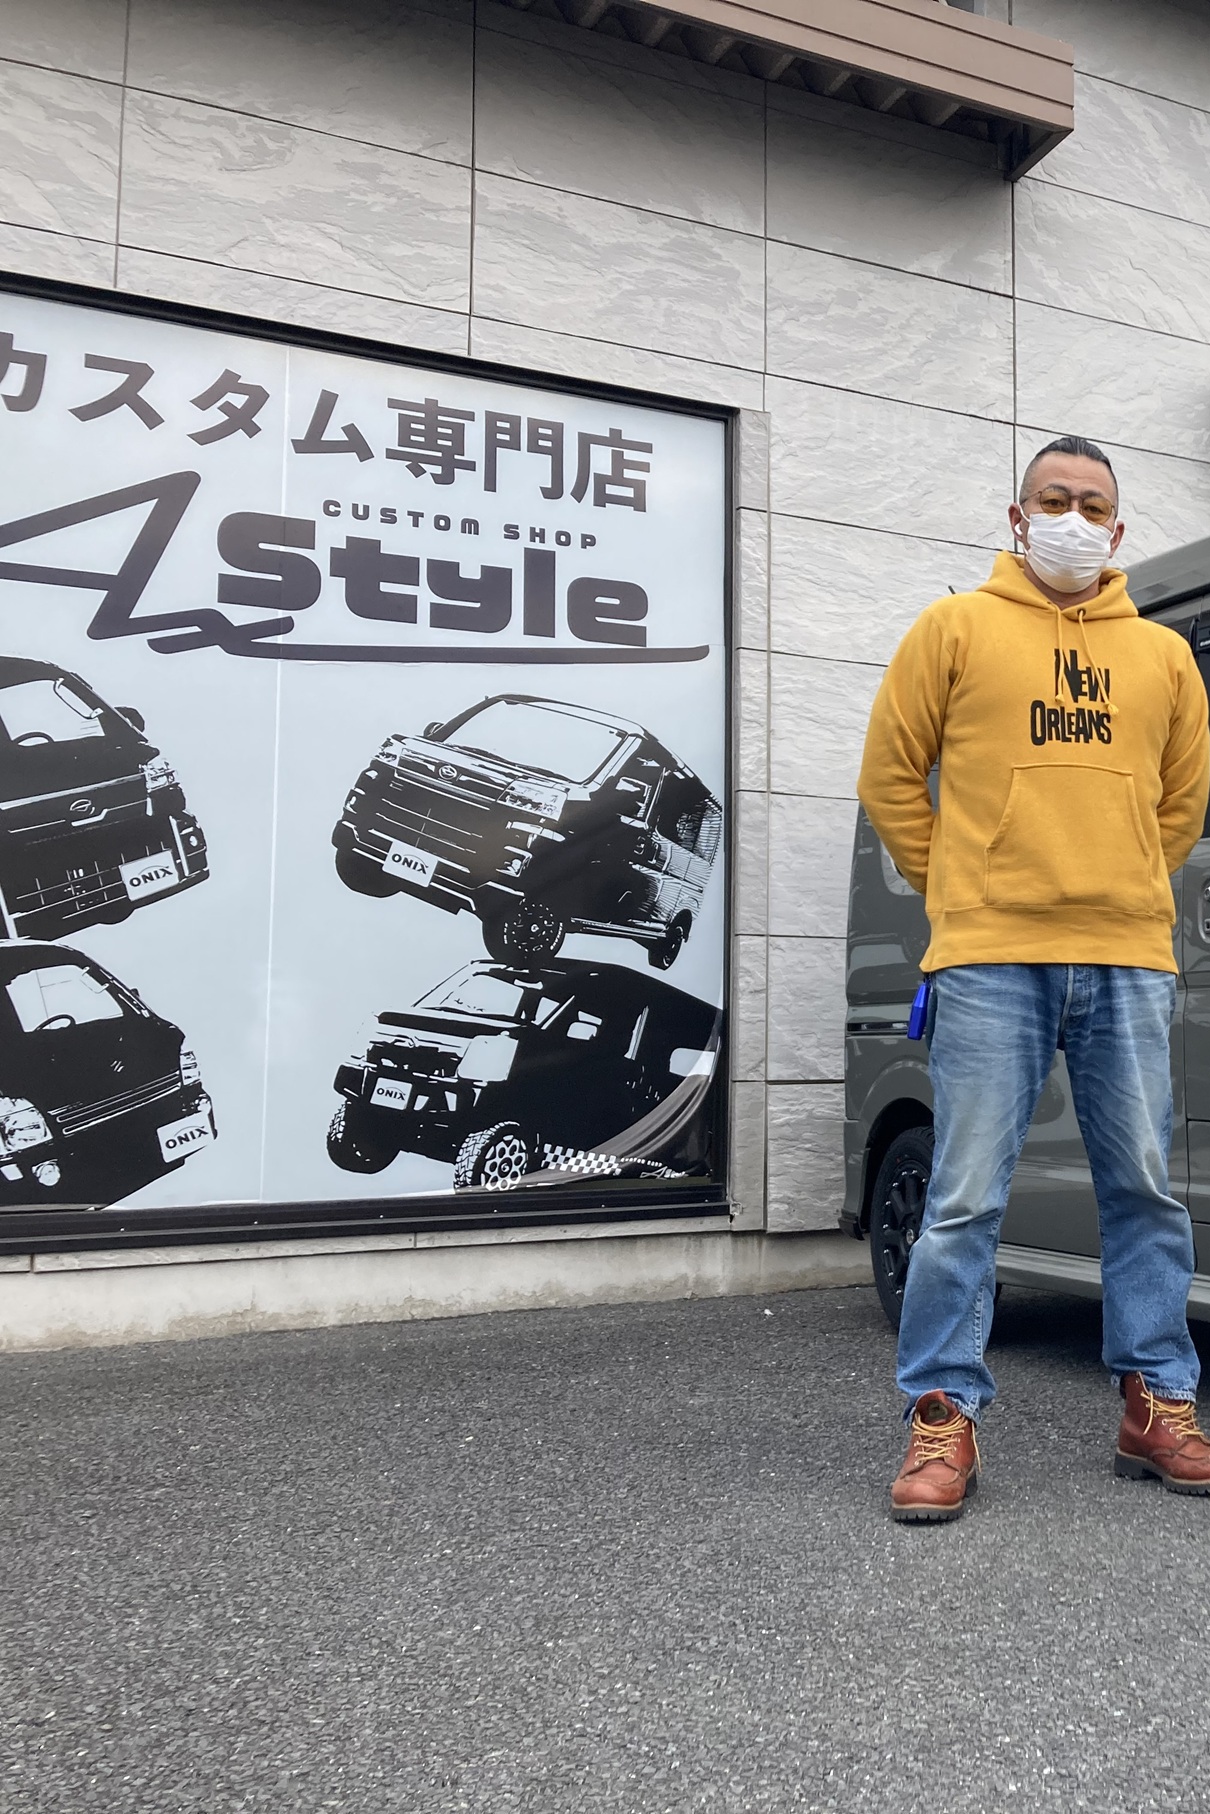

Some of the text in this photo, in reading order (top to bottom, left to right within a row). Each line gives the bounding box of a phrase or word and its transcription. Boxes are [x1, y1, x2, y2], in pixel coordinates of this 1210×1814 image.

[0, 331, 653, 513] カスタム専門店
[323, 500, 597, 549] CUSTOM SHOP
[1030, 700, 1112, 746] ORLEANS
[391, 853, 427, 875] ONIX
[129, 868, 173, 887] ONIX
[376, 1087, 405, 1101] ONIX
[165, 1128, 209, 1149] ONIX
